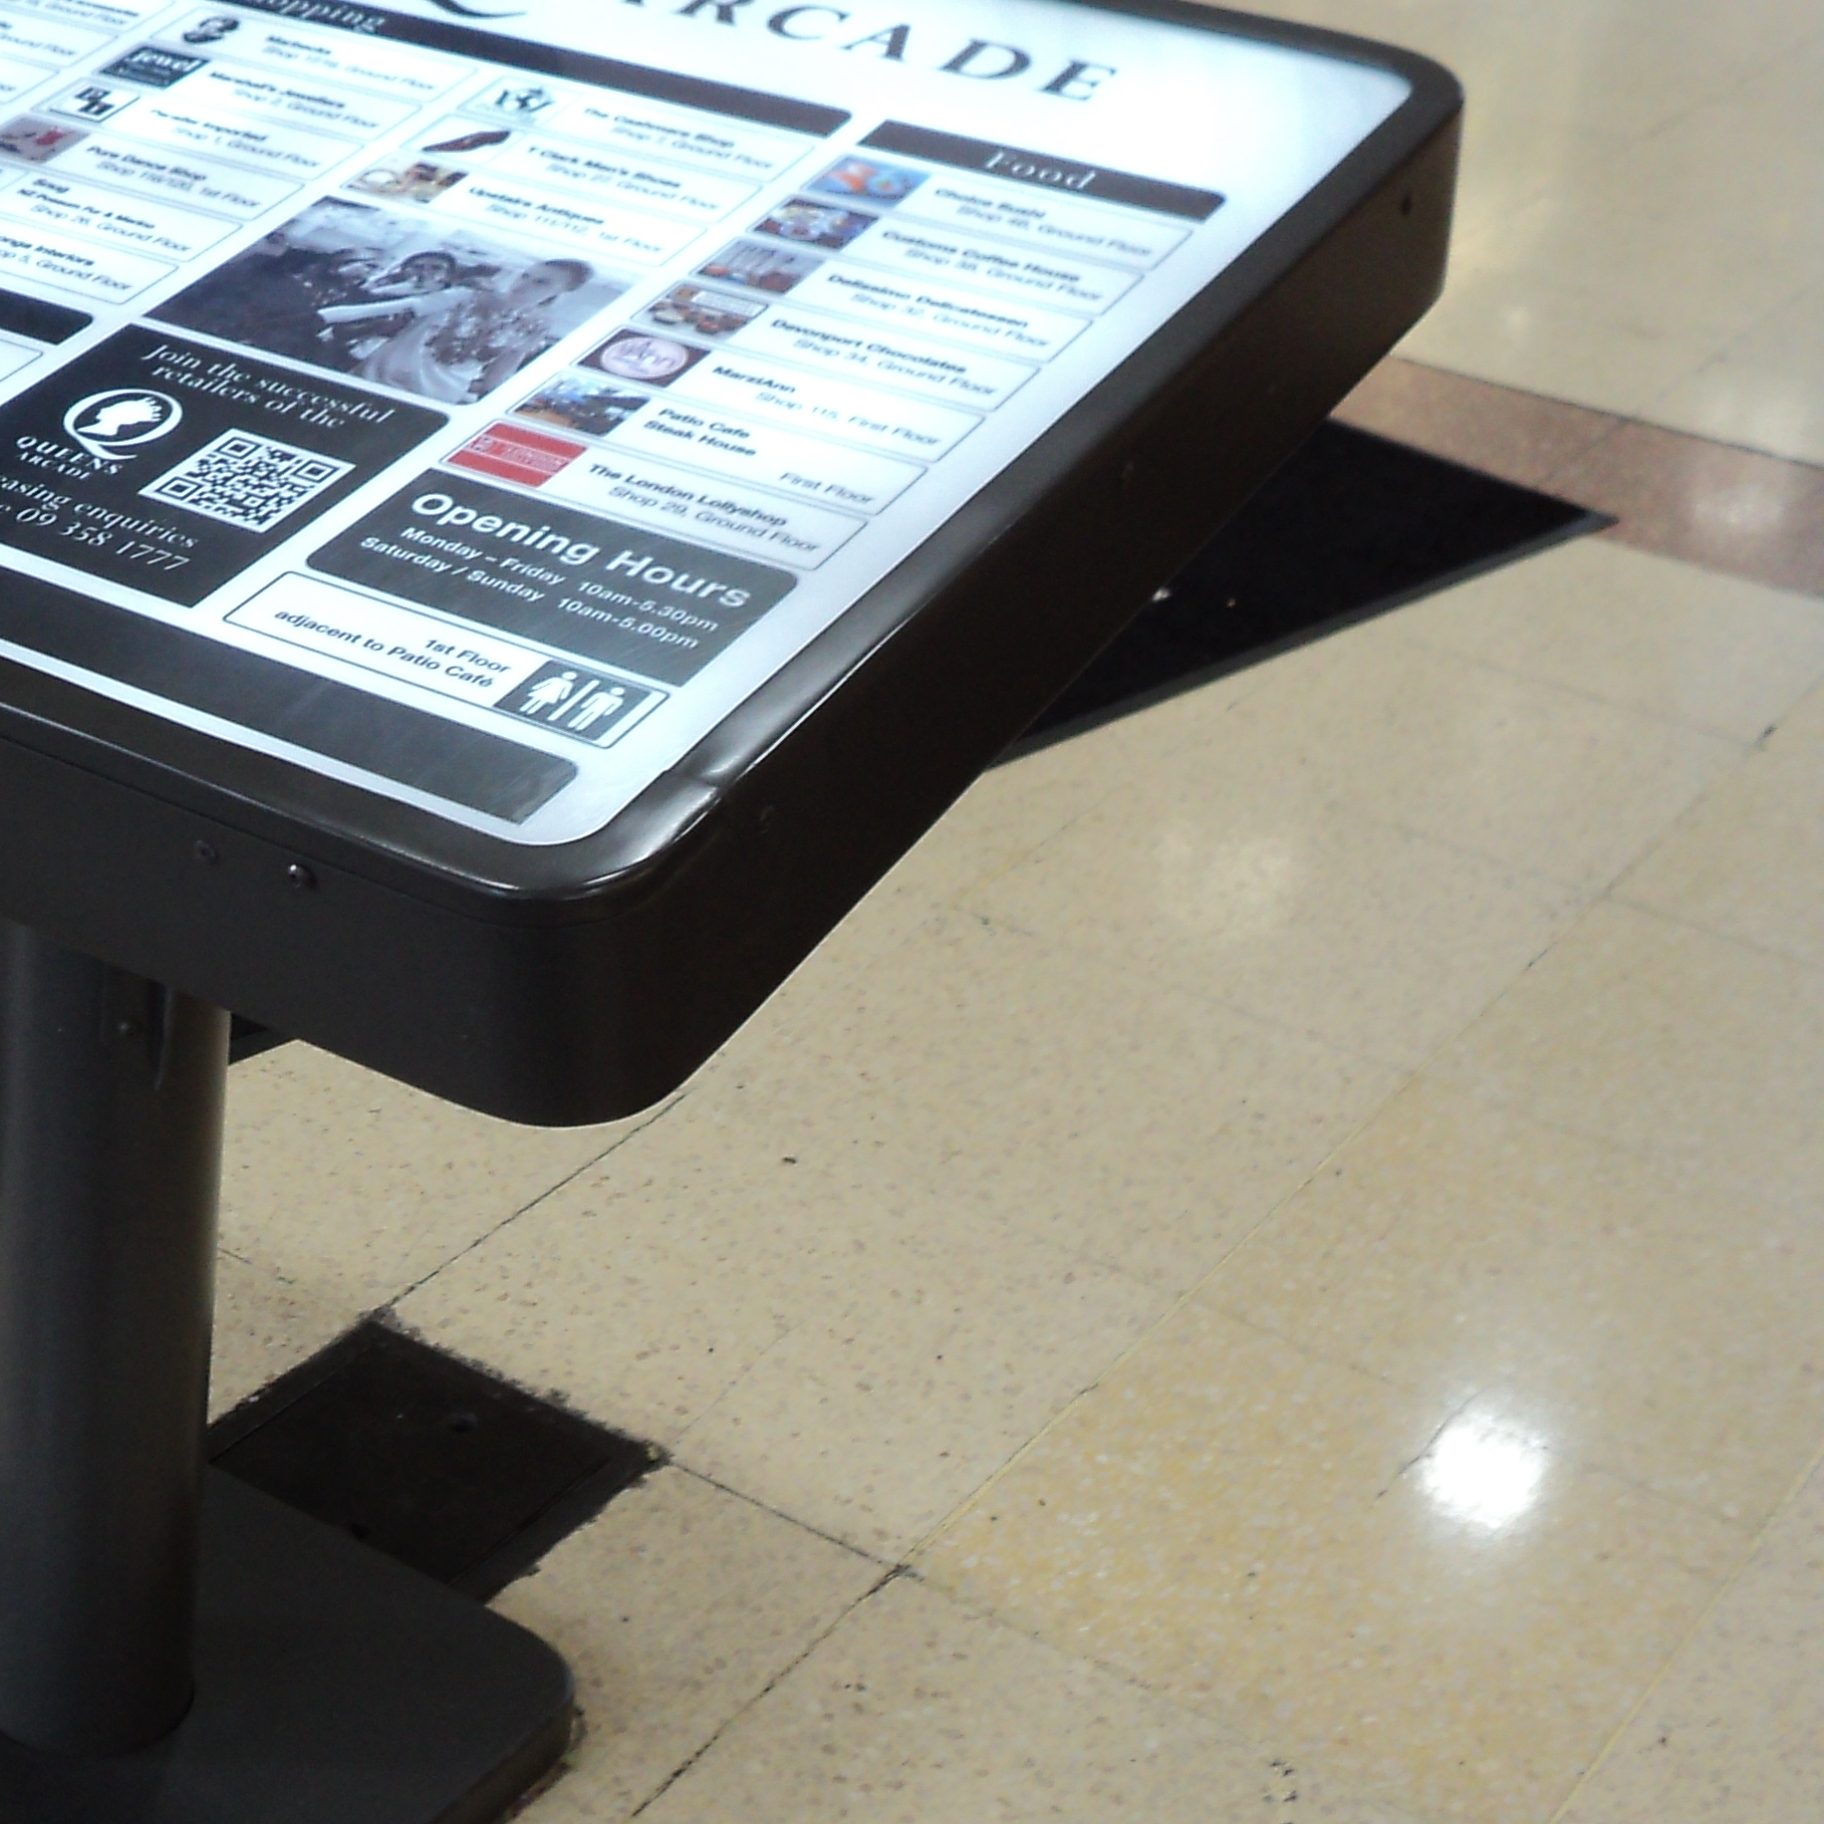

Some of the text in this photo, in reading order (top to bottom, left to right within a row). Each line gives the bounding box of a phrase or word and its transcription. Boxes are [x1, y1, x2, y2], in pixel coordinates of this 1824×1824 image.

[121, 155, 168, 171] Dance
[169, 167, 208, 181] Shop
[984, 152, 1097, 188] Food
[30, 204, 69, 219] Shop
[96, 223, 154, 241] Ground
[152, 237, 191, 252] Floor
[35, 260, 94, 280] Ground
[91, 275, 132, 290] Floor
[770, 319, 968, 374] Devonport Chocolates
[850, 293, 897, 310] Shop
[933, 313, 1002, 335] Ground
[1004, 330, 1050, 347] Floor
[141, 345, 395, 423] Join the successful
[794, 339, 841, 356] Shop
[877, 361, 947, 383] Ground
[949, 377, 997, 395] Floor
[151, 366, 258, 403] retailers
[299, 408, 346, 427] the
[658, 408, 751, 438] Patio Cafe
[755, 392, 803, 410] Shop
[847, 416, 889, 432] First
[891, 427, 941, 445] Floor
[16, 436, 123, 474] QUEENS
[643, 421, 757, 456] Steak House
[19, 452, 91, 480] ARCADE
[779, 472, 875, 504] First Floor
[589, 464, 788, 526] The London Lollyshop
[608, 486, 659, 507] Shop
[694, 511, 769, 538] Ground
[768, 531, 821, 552] Floor
[15, 506, 58, 526] 09
[60, 522, 113, 546] 358
[115, 540, 190, 570] 1777
[72, 503, 196, 549] enquiries
[409, 493, 753, 608] Opening Hours
[360, 537, 453, 572] Saturday
[466, 570, 546, 602] Sunday
[557, 598, 699, 649] 10am-5.00pm
[400, 527, 484, 560] Monday
[499, 558, 567, 585] Friday
[577, 582, 719, 632] 10am-5.30pm
[274, 611, 494, 688] adjacent to Patio Café
[425, 639, 511, 673] 1st Floor
